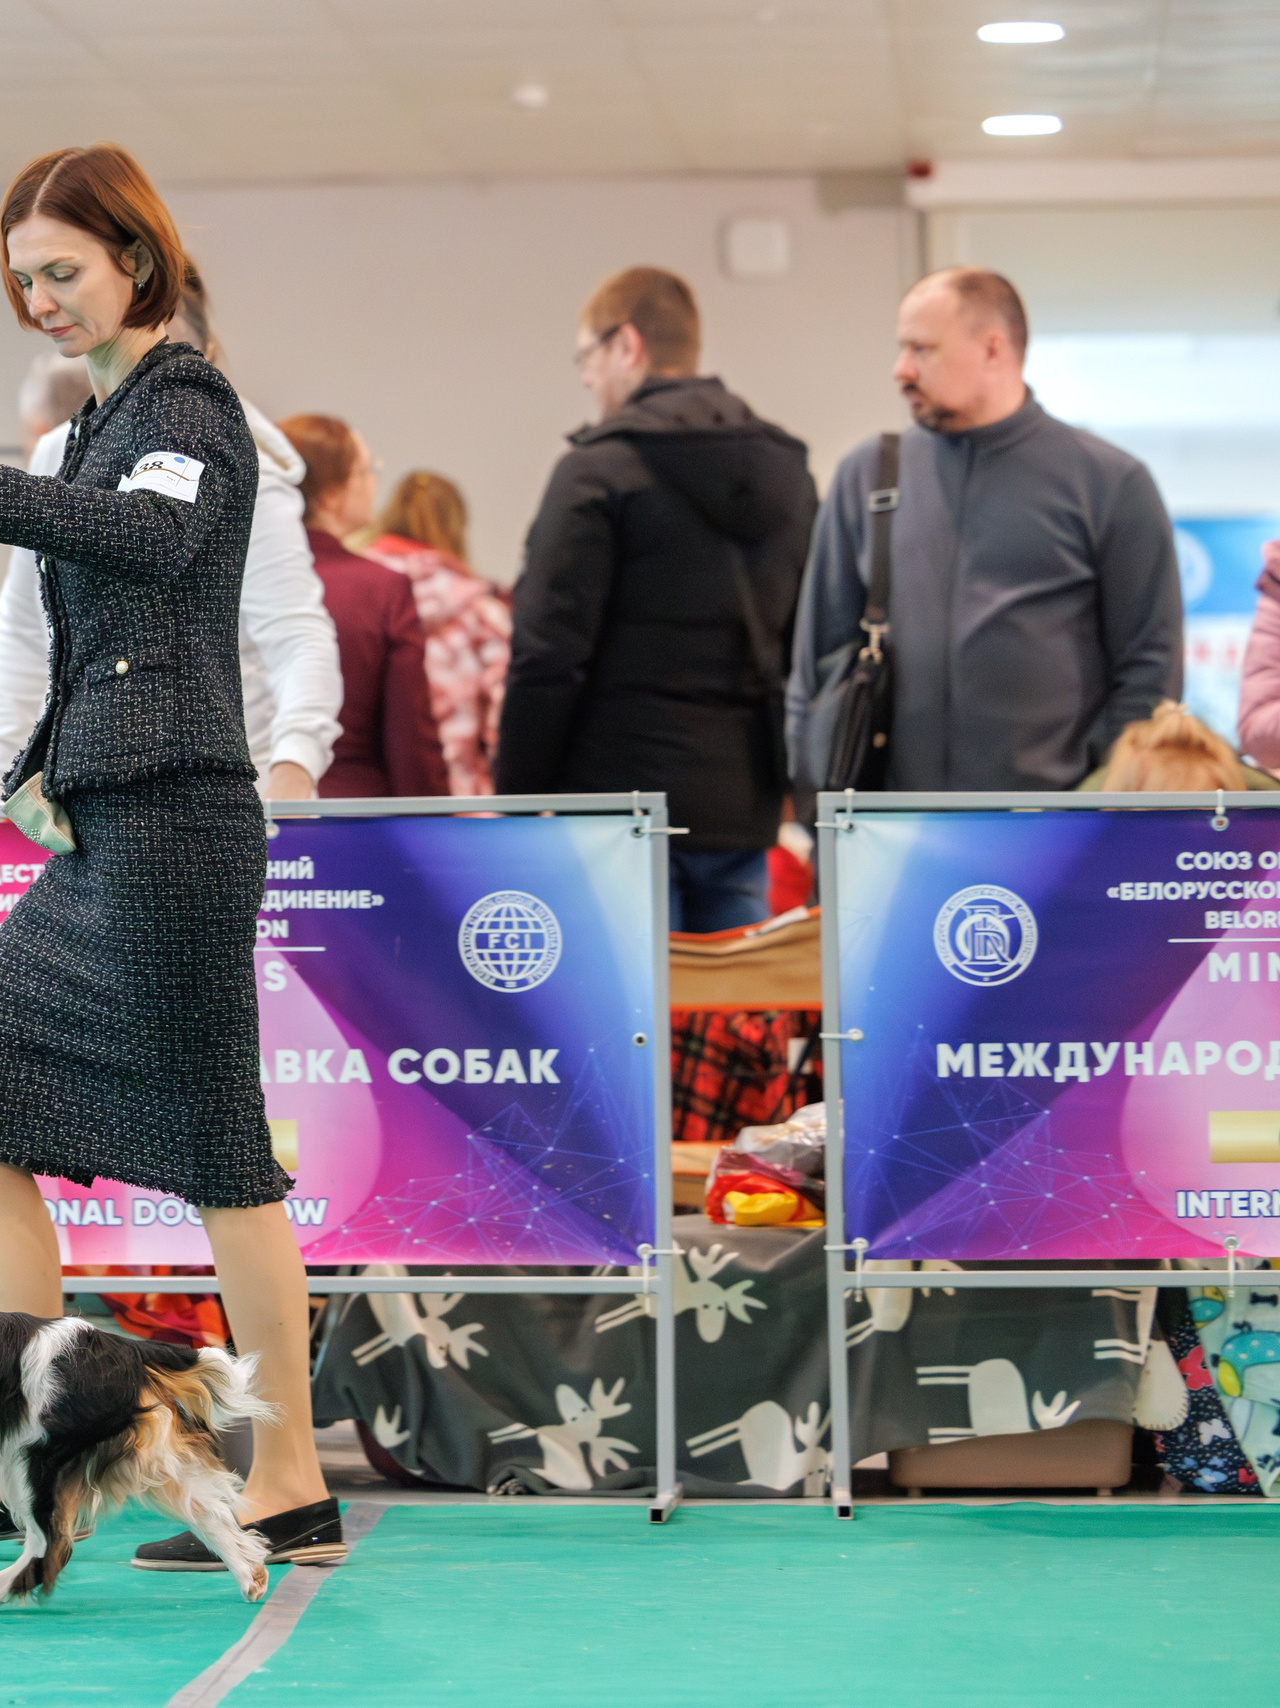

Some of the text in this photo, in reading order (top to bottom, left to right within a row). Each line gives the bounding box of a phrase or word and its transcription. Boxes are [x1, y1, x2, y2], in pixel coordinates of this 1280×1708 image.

[1176, 851, 1254, 871] СОЮЗ
[487, 933, 532, 950] FCI
[387, 1048, 561, 1084] СОБАК
